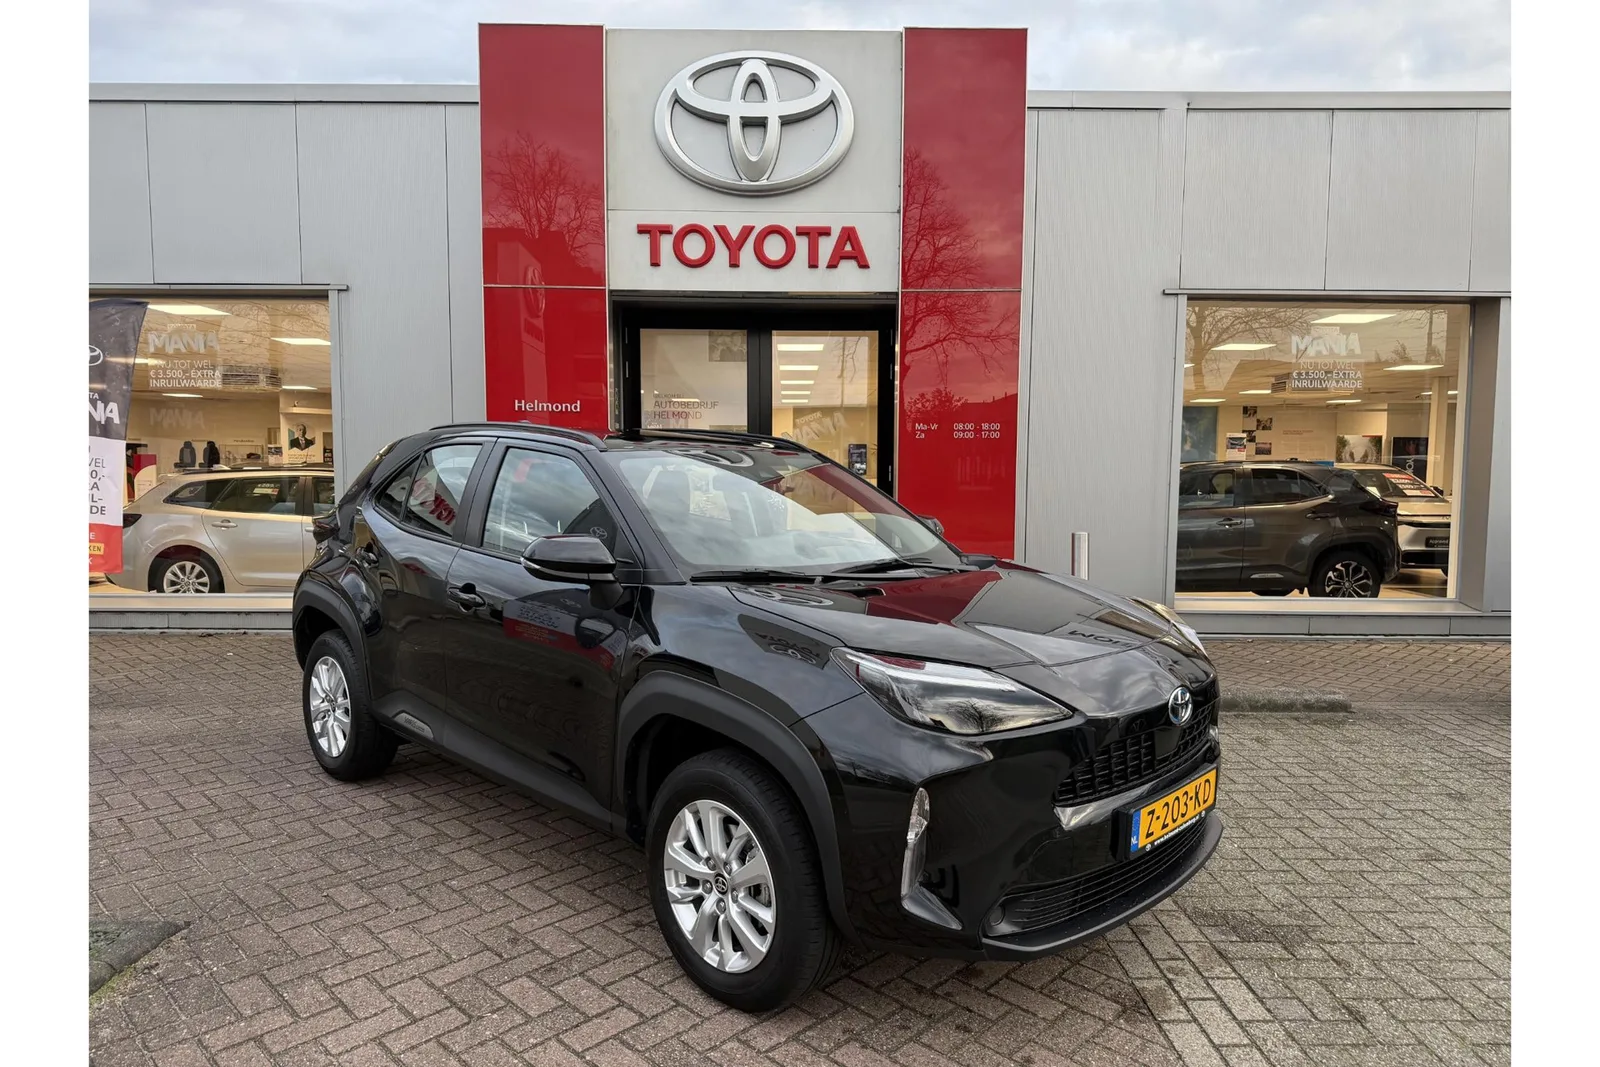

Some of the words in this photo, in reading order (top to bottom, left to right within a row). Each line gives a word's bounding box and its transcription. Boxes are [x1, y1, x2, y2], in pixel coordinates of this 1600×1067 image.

[636, 223, 871, 269] TOYOTA
[174, 360, 191, 369] TOT
[1300, 361, 1314, 370] NU
[1317, 361, 1333, 370] TOT
[150, 379, 222, 388] INRUILWAARDE
[1292, 380, 1363, 388] INRUILWAARDE
[514, 399, 581, 413] Helmond
[653, 401, 719, 410] AUTOBEDRIJF
[653, 410, 702, 420] HELMOND
[796, 410, 823, 425] TOYOTA
[915, 423, 938, 431] Ma-Vr
[953, 422, 975, 431] 08:00
[981, 422, 1000, 431] 18:00
[915, 431, 925, 439] Za
[953, 431, 975, 439] 09:00
[981, 431, 1000, 439] 17:00
[1145, 778, 1212, 840] Z-203-KD
[1131, 835, 1138, 846] NL
